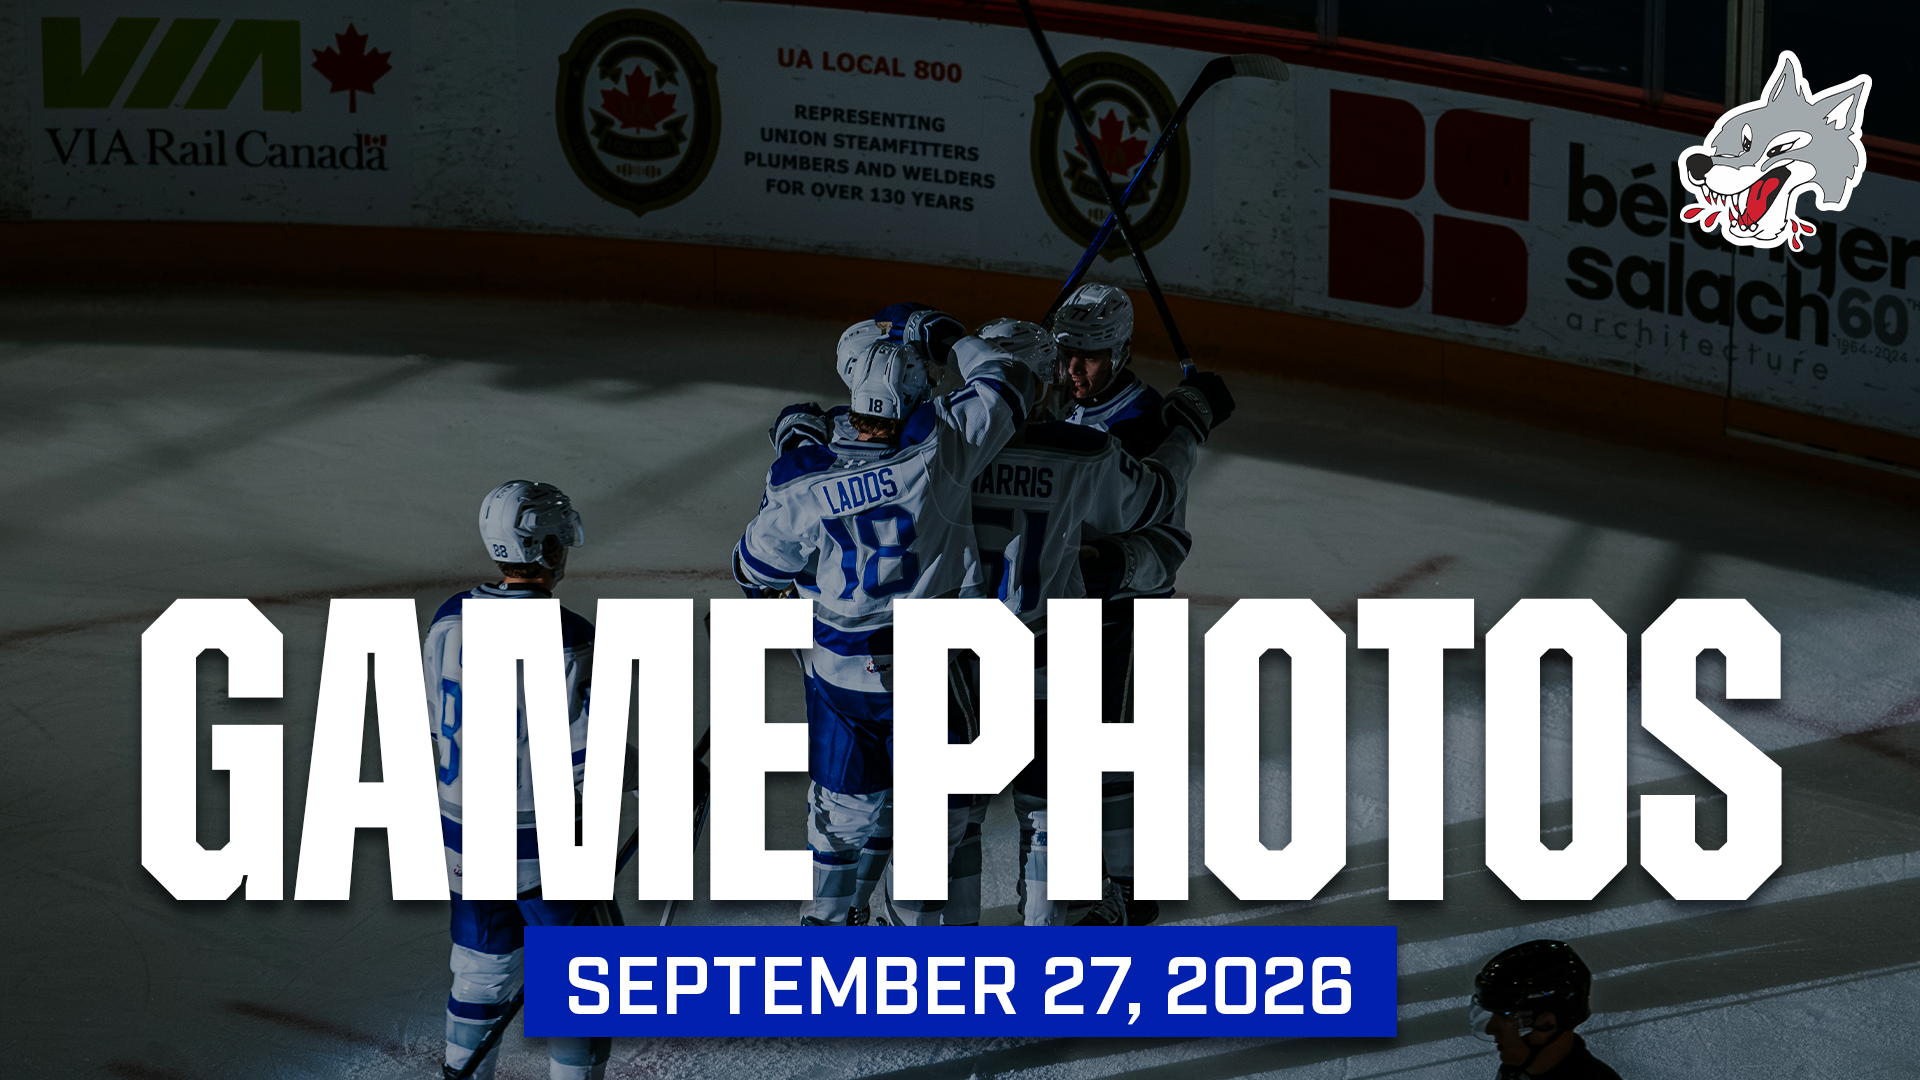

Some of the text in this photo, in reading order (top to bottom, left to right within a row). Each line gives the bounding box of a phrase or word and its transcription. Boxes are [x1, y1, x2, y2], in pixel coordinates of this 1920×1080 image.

[41, 16, 302, 112] VIA
[778, 47, 962, 83] UA LOCAL 800
[620, 99, 655, 121] UA
[795, 105, 946, 133] REPRESENTING
[44, 127, 389, 171] VIA Rail Canada
[605, 135, 648, 155] LOCAL
[760, 127, 980, 162] UNION STEAMFITTERS
[744, 152, 996, 189] PLUMBERS AND WELDERS
[766, 179, 974, 212] FOR OVER 130 YEARS
[1565, 241, 1829, 347] salach
[1070, 307, 1091, 321] 77
[1566, 311, 1829, 381] architecture
[868, 397, 883, 413] 18
[822, 467, 898, 514] LADDS
[821, 505, 921, 600] 18
